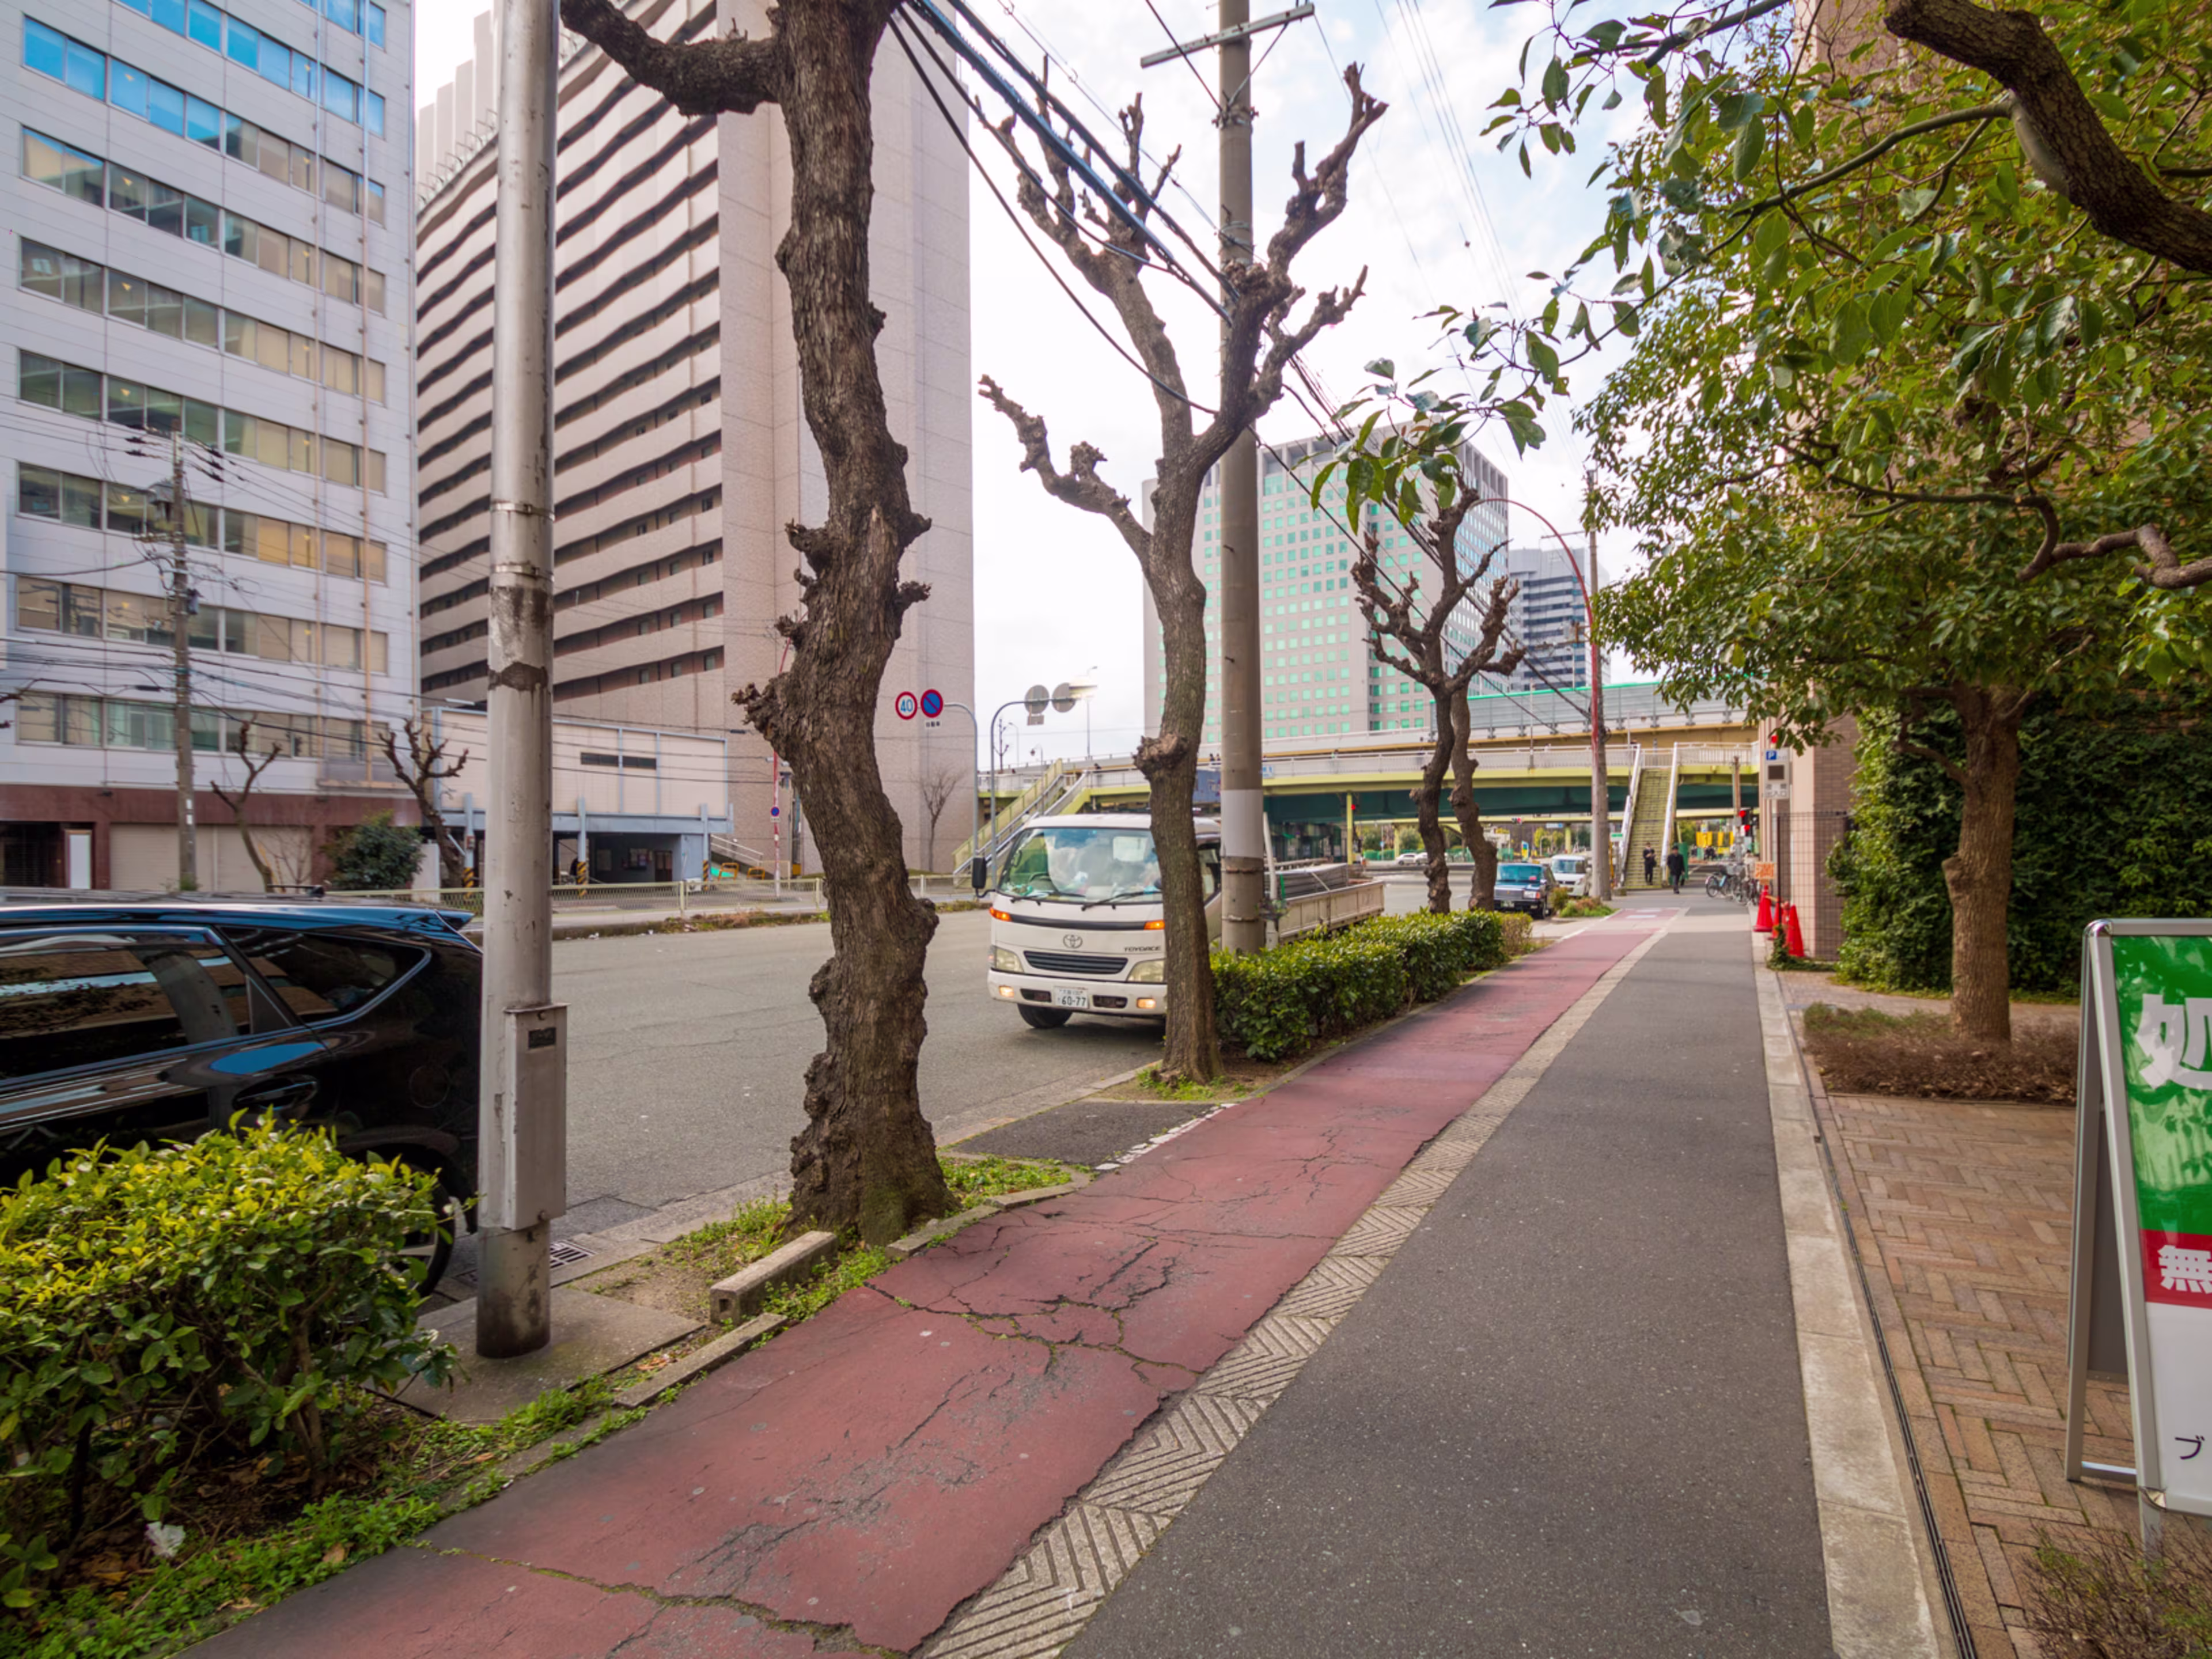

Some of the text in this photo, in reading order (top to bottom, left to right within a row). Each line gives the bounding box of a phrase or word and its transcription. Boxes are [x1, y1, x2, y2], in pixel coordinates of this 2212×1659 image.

[900, 699, 913, 712] 40
[1062, 996, 1086, 1006] 60-77
[2157, 1244, 2212, 1294] 無
[2175, 1435, 2205, 1460] ブ
